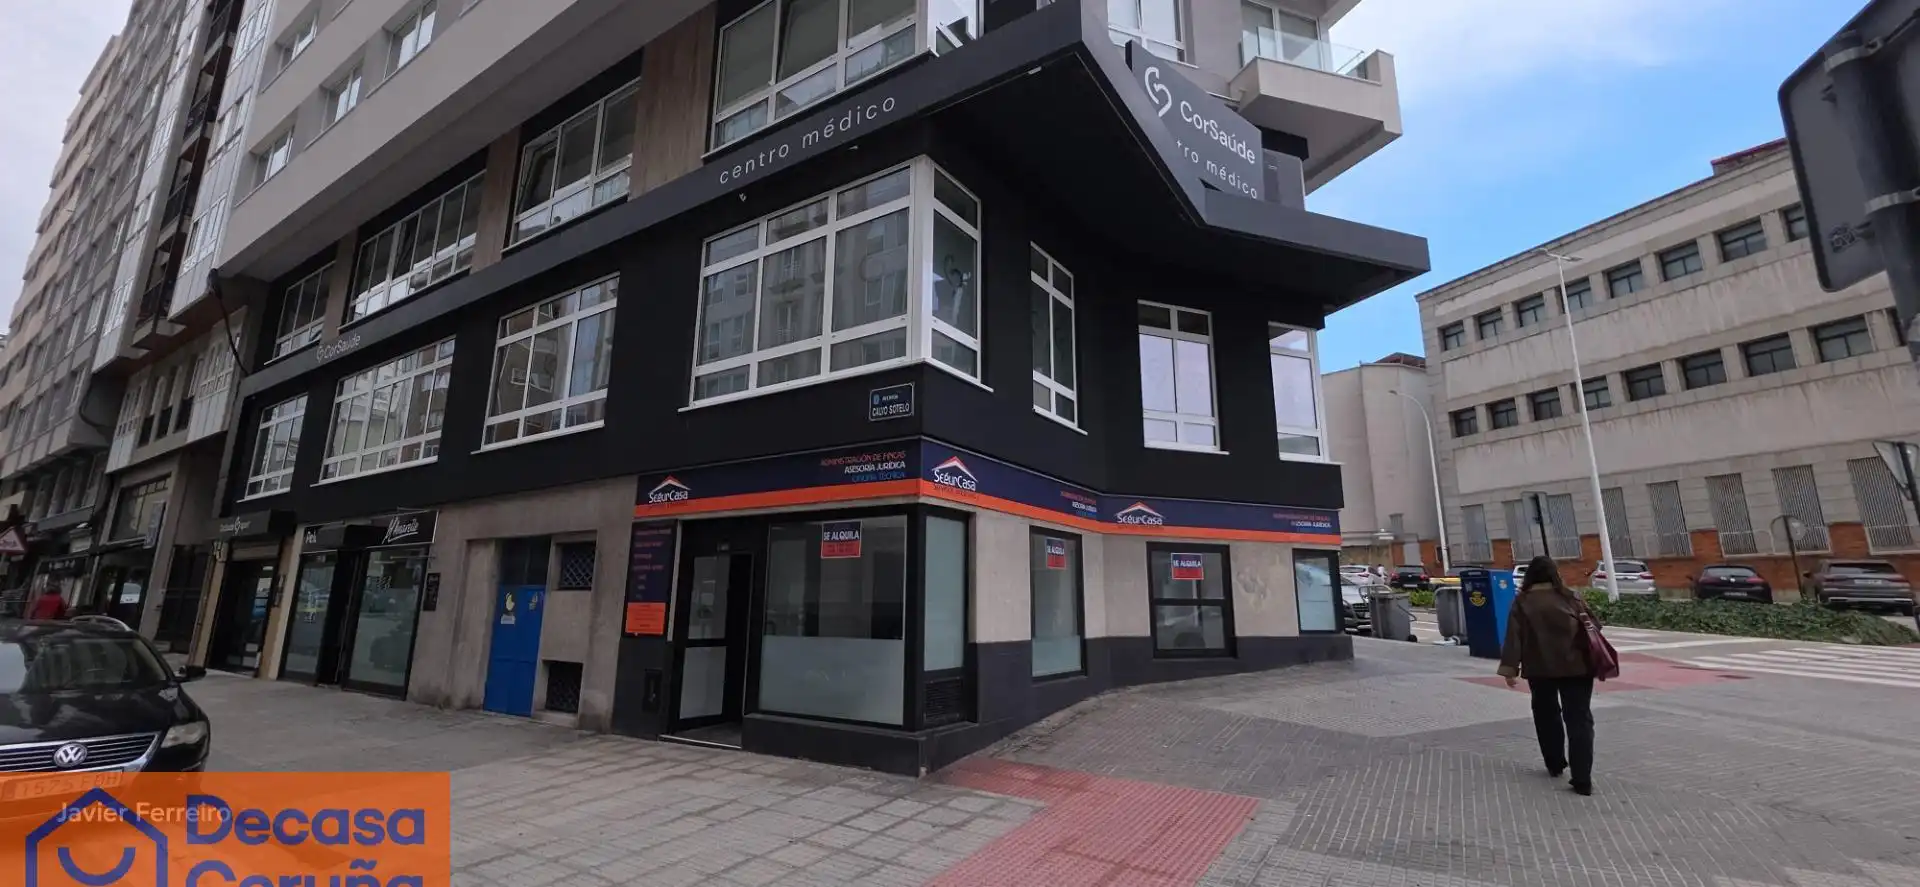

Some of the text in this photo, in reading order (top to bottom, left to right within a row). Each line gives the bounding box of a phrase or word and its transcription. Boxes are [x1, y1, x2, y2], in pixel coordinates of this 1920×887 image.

[719, 97, 896, 185] centro médico
[1180, 100, 1256, 164] CorSaúde
[1176, 137, 1257, 199] tro médico
[889, 402, 910, 415] SOTELO
[823, 530, 860, 542] SE ALQUILA
